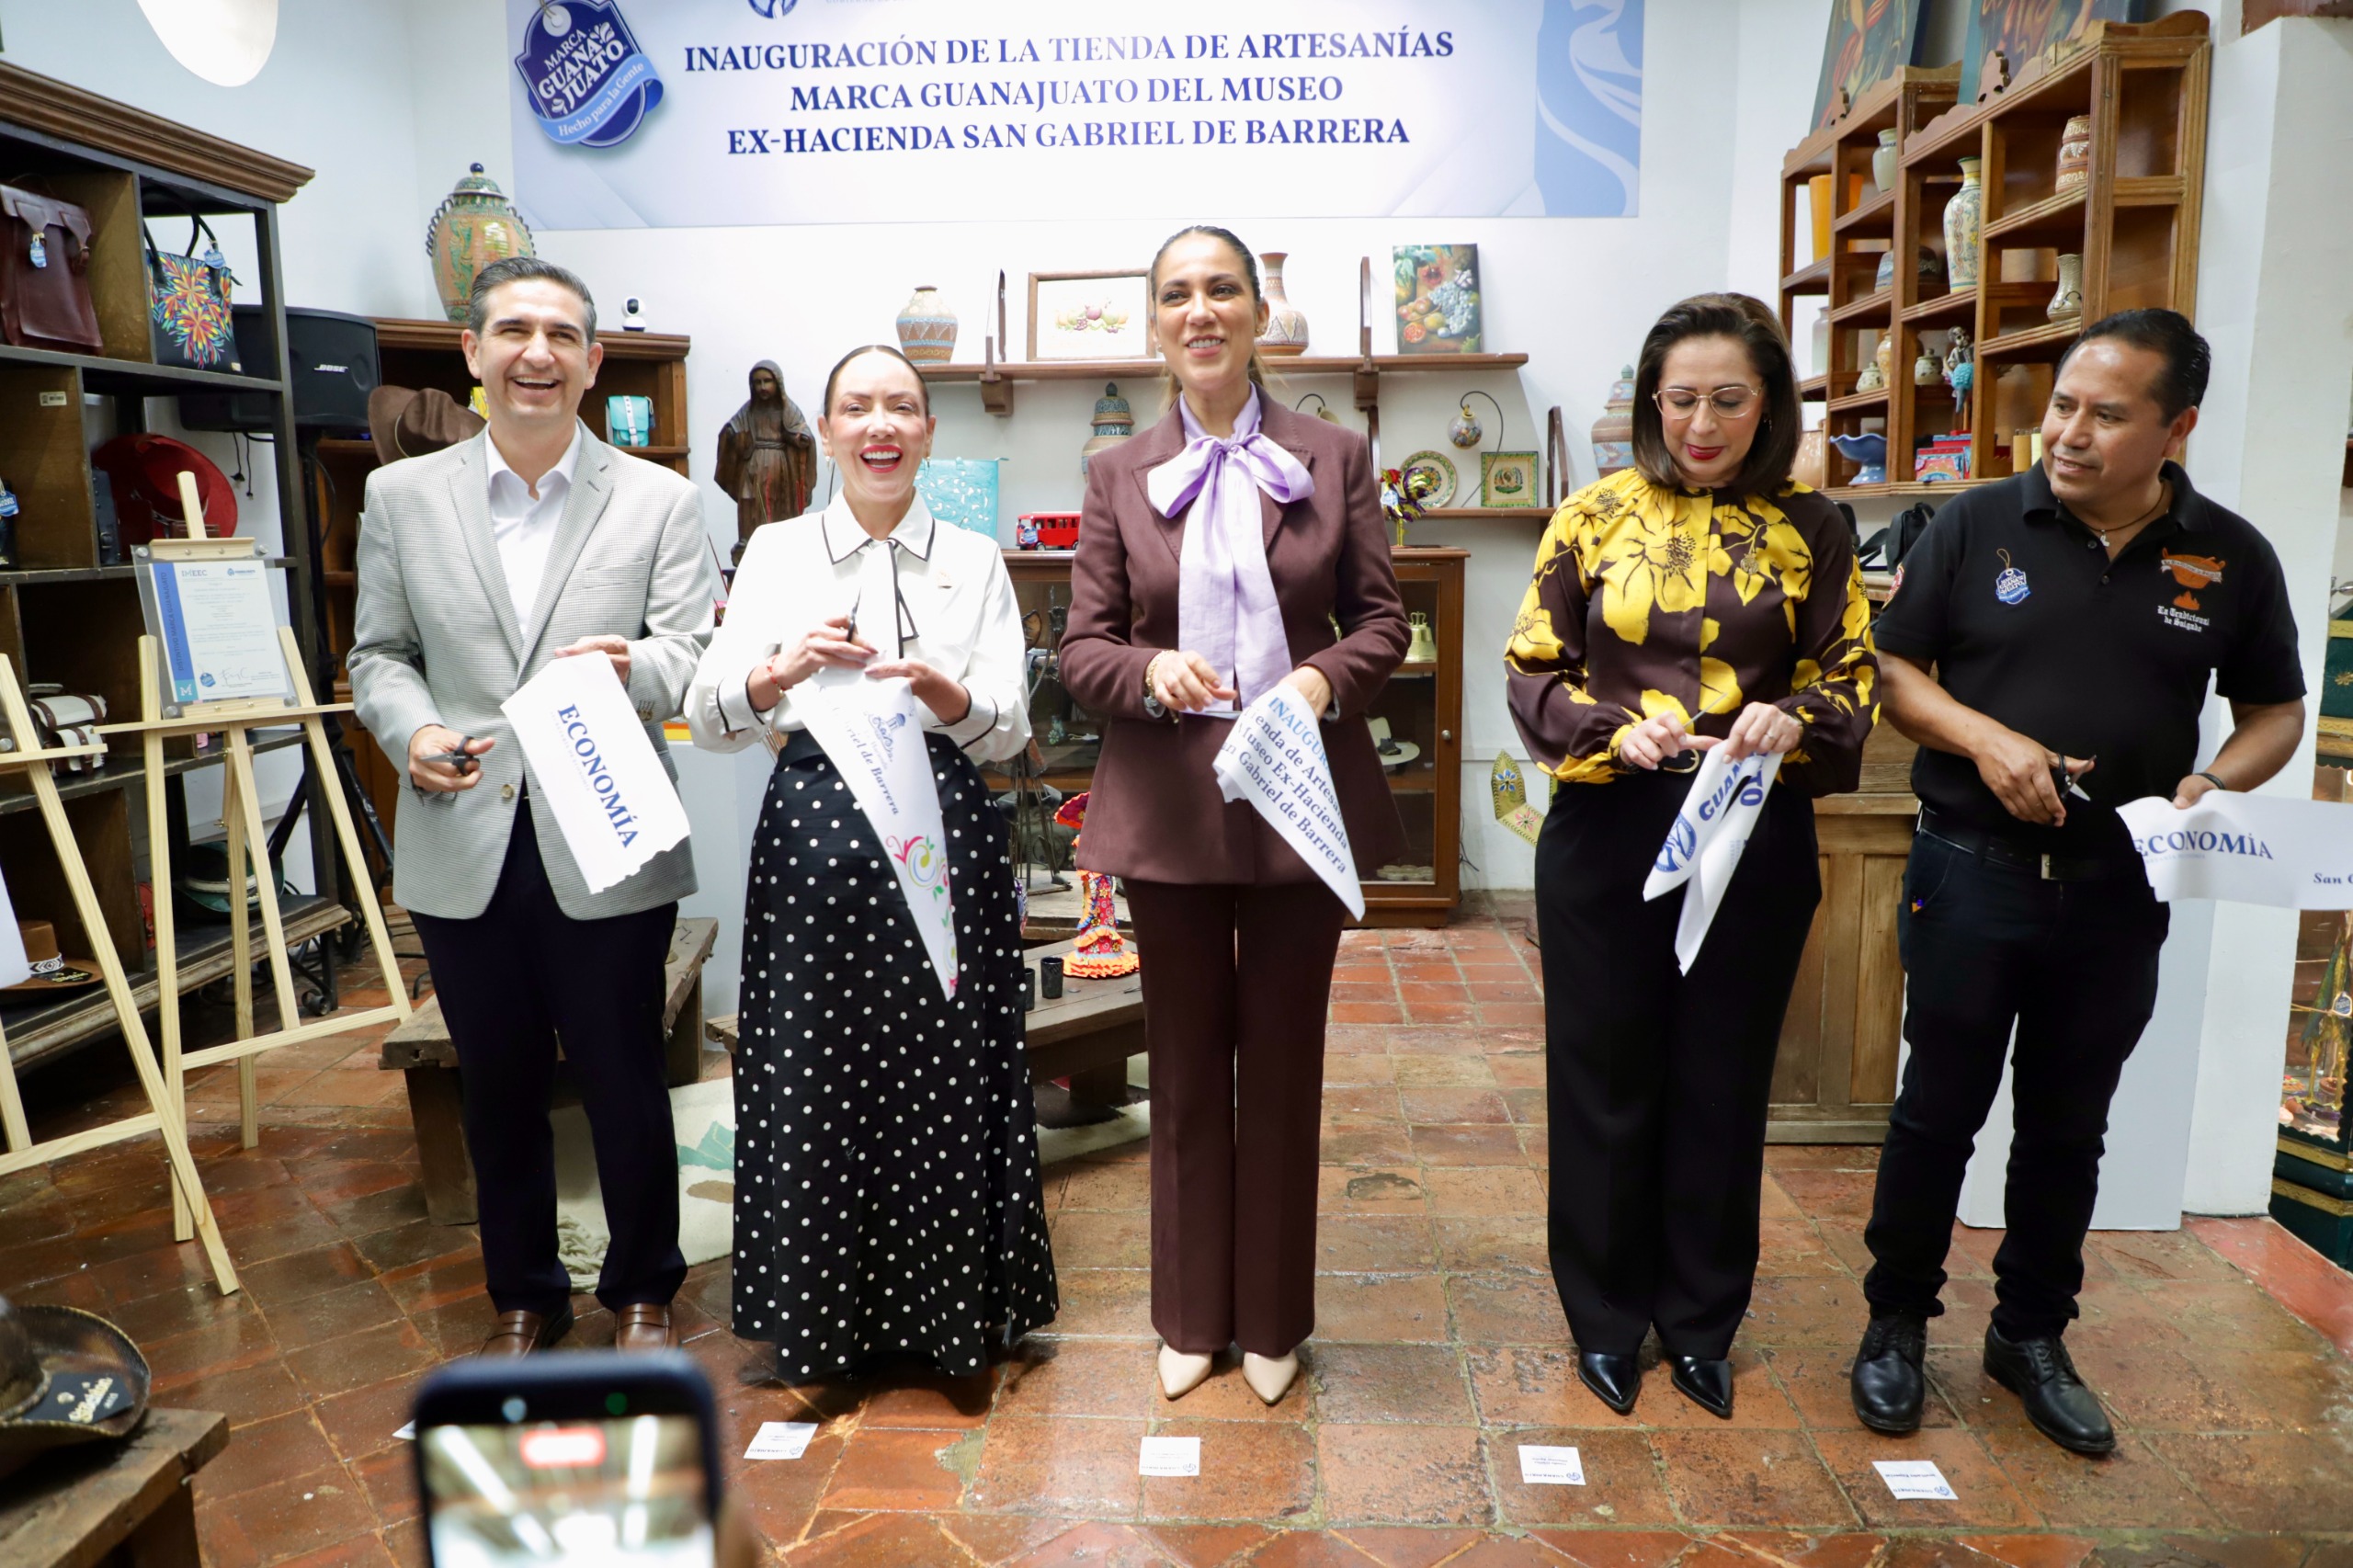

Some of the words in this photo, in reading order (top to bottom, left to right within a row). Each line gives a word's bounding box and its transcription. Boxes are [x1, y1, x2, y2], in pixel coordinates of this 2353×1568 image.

[538, 38, 603, 99] GUANA
[544, 28, 587, 72] MARCA
[562, 40, 624, 109] JUATO
[685, 35, 937, 72] INAUGURACIÓN
[947, 40, 989, 64] DE
[999, 39, 1040, 63] LA
[1049, 36, 1176, 62] TIENDA
[1186, 35, 1229, 59] DE
[1237, 26, 1454, 59] ARTESANÍAS
[558, 115, 592, 137] Hecho
[591, 97, 612, 122] para
[611, 85, 620, 100] la
[617, 62, 644, 89] Gente
[790, 84, 913, 111] MARCA
[921, 79, 1139, 112] GUANAJUATO
[1147, 78, 1212, 103] DEL
[1221, 75, 1343, 102] MUSEO
[727, 124, 956, 154] EX-HACIENDA
[963, 124, 1027, 149] SAN
[1035, 120, 1185, 147] GABRIEL
[1193, 119, 1237, 145] DE
[1245, 119, 1411, 144] BARRERA
[314, 364, 348, 373] BOSE
[167, 614, 177, 636] MARCA
[1268, 697, 1331, 778] INAUGUR
[1285, 748, 1303, 767] de
[558, 703, 638, 848] ECONOMÍA
[860, 749, 874, 765] de
[870, 767, 900, 815] Barrera
[1239, 751, 1283, 803] Gabriel
[1279, 799, 1298, 822] de
[1297, 817, 1346, 874] Barrera
[1272, 762, 1347, 849] Ex-Hacienda
[2313, 872, 2341, 884] San
